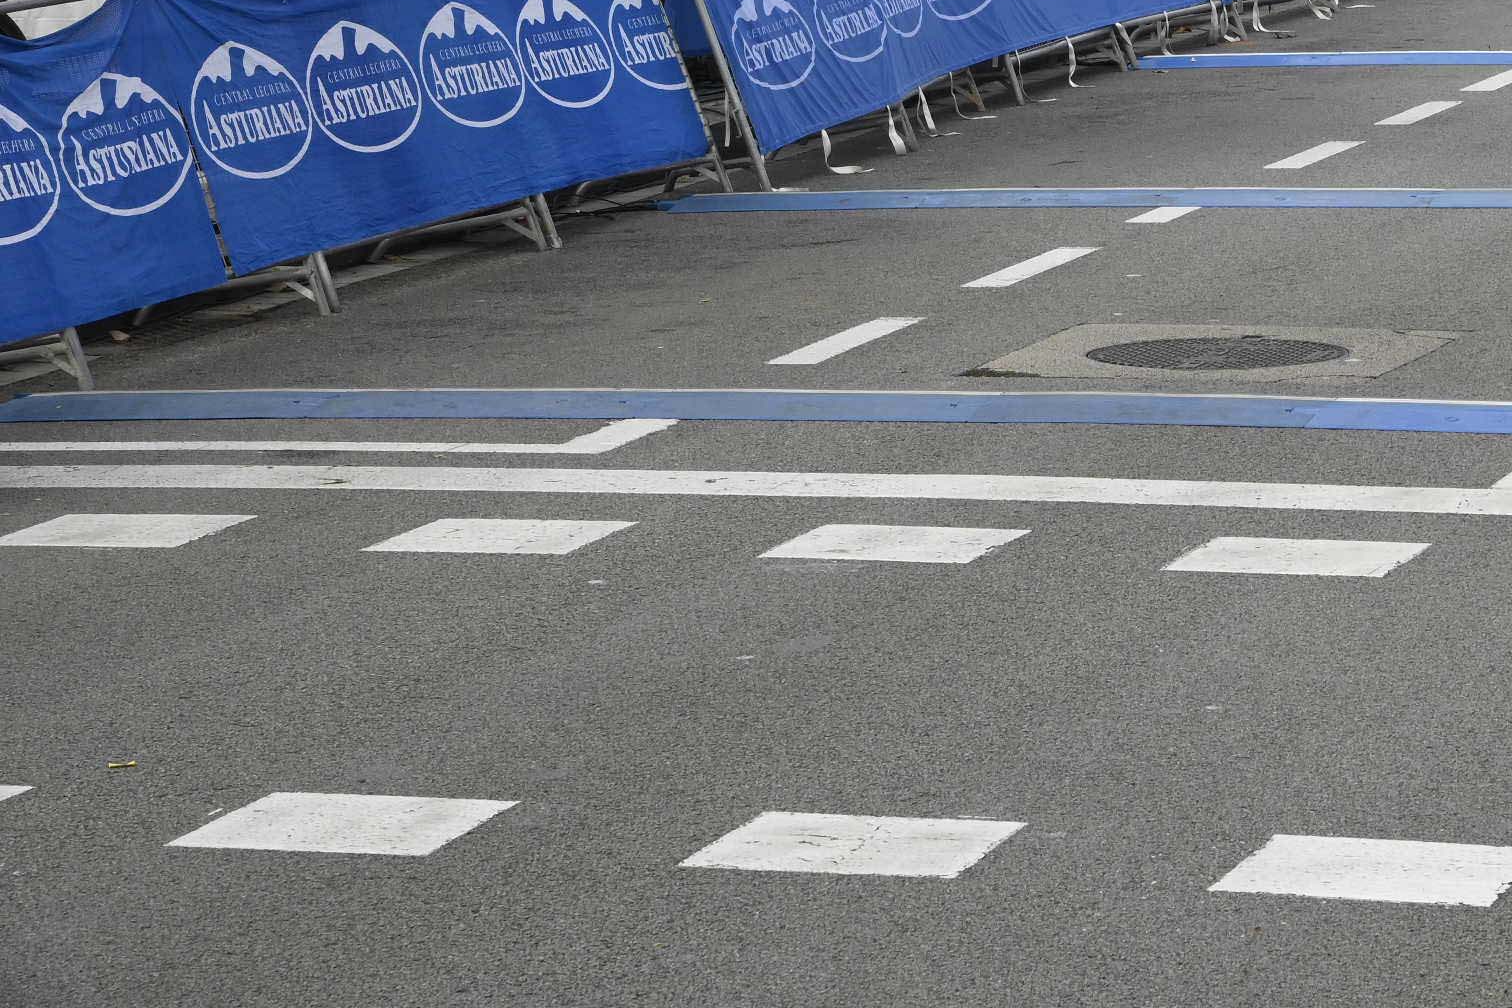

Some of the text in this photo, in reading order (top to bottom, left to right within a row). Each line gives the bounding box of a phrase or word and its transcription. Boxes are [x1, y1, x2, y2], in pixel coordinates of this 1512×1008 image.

[524, 37, 610, 83] ASTURIANA
[617, 21, 680, 67] ASTUR
[316, 75, 417, 126] ASTURIANA
[429, 53, 521, 101] ASTURIANA
[203, 98, 308, 152] ASTURIANA
